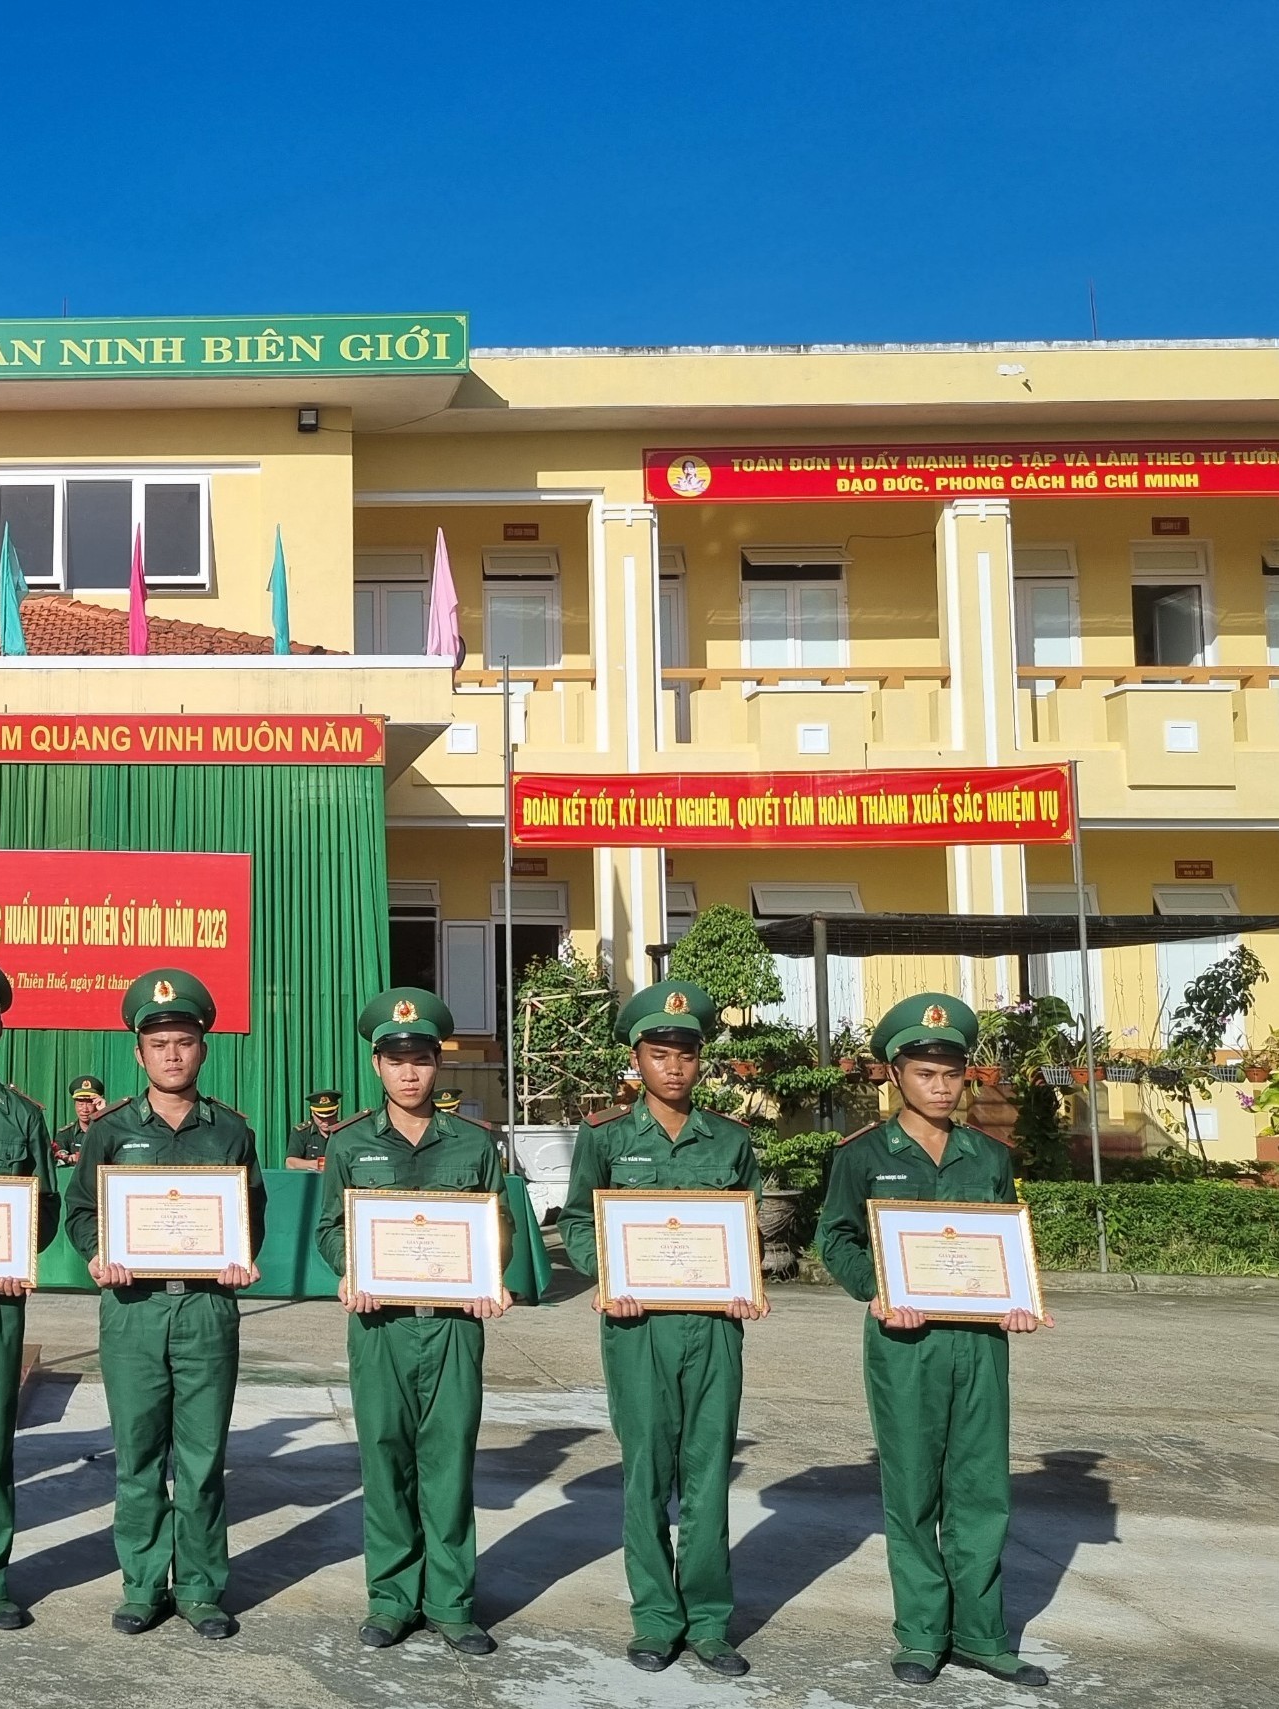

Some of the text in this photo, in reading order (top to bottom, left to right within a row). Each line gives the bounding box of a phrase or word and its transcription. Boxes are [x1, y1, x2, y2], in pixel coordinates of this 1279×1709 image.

[59, 337, 186, 366] NINH
[201, 329, 325, 363] BIÊN
[339, 325, 451, 361] GIỚI
[731, 456, 783, 472] TOÀN
[789, 457, 830, 472] ĐƠN
[837, 457, 855, 473] VỊ
[861, 451, 900, 470] ĐẨY
[906, 456, 967, 472] MẠNH
[973, 455, 1013, 471] HỌC
[1019, 451, 1057, 470] TẬP
[1064, 451, 1090, 467] VÀ
[1096, 450, 1139, 466] LÀM
[1145, 452, 1195, 466] THEO
[1201, 451, 1227, 465] TƯ
[836, 471, 1199, 495] ĐẠO ĐỨC, PHONG CÁCH HỒ CHÍ MINH
[30, 725, 131, 753] QUANG
[139, 726, 203, 751] VINH
[213, 721, 293, 752] MUÔN
[302, 721, 363, 752] NĂM
[522, 781, 1059, 832] ĐOÀN KẾT TỐT, KỶ LUẬT NGHIÊM, QUYẾT TÂM HOÀN THÀNH XUẤT SẮC NHIỆM VỤ
[4, 891, 38, 944] HUẤN
[41, 897, 79, 954] LUYỆN
[82, 893, 119, 946] CHIẾN
[122, 899, 136, 947] SĨ
[138, 899, 162, 947] MỚI
[165, 899, 194, 947] NĂM
[197, 908, 227, 949] 2023
[17, 972, 44, 989] Thiên
[46, 971, 68, 992] Huế,
[70, 973, 93, 993] ngày
[95, 974, 105, 990] 21
[108, 974, 136, 990] thán
